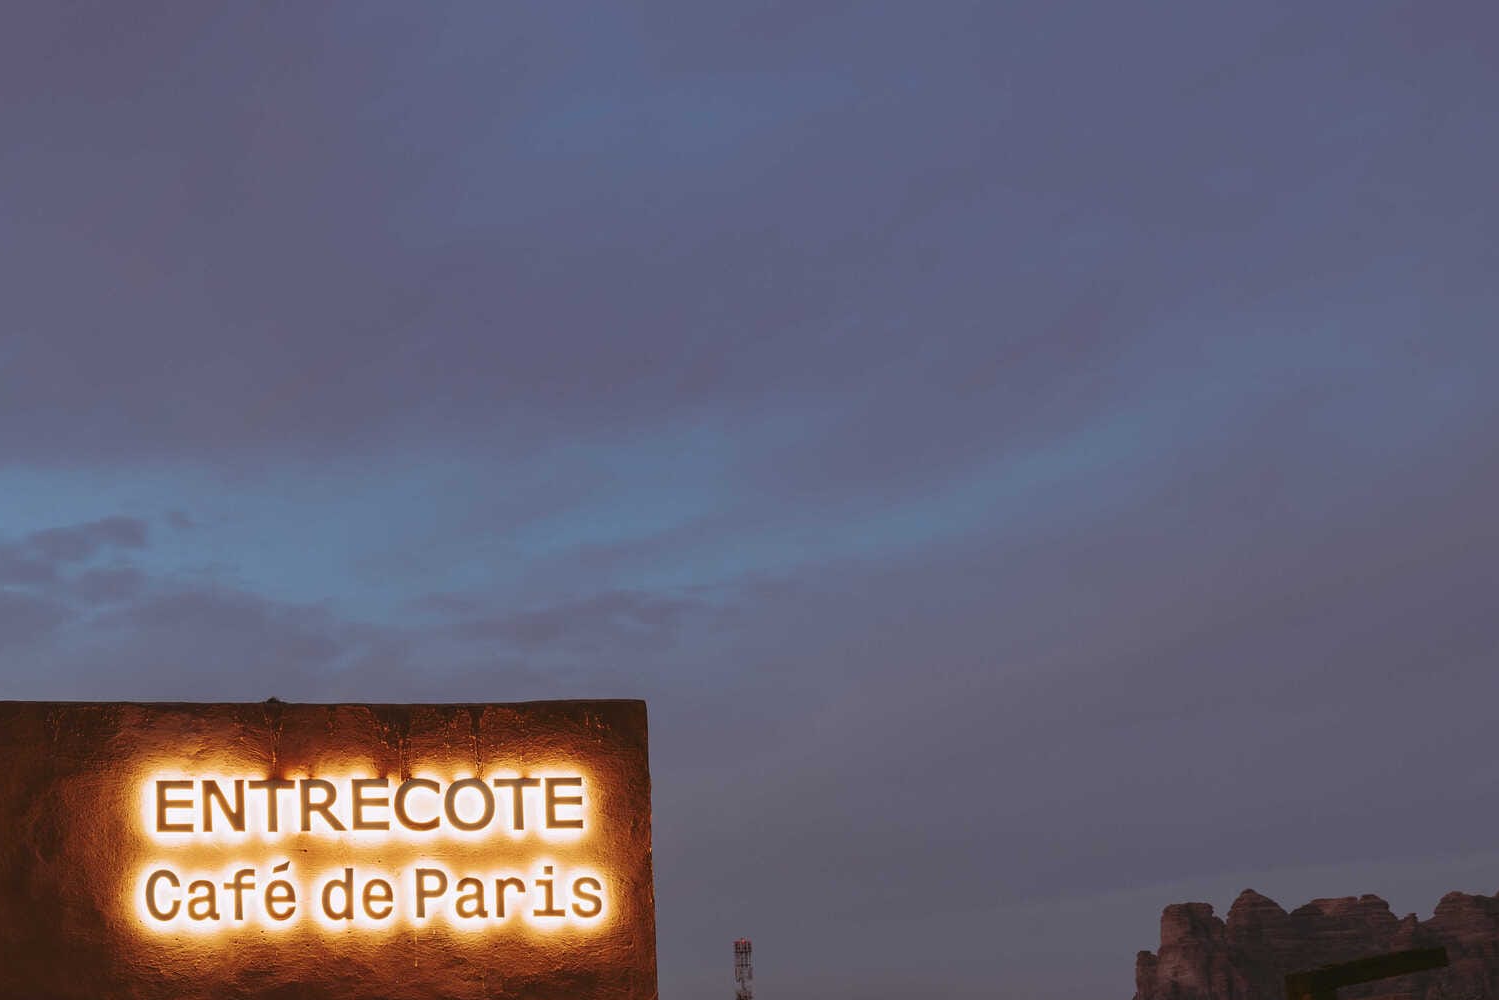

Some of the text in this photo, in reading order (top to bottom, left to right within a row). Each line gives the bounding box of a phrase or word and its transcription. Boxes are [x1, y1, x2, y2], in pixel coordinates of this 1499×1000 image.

[155, 777, 585, 833] ENTRECOTE
[145, 861, 603, 922] Café de Paris
